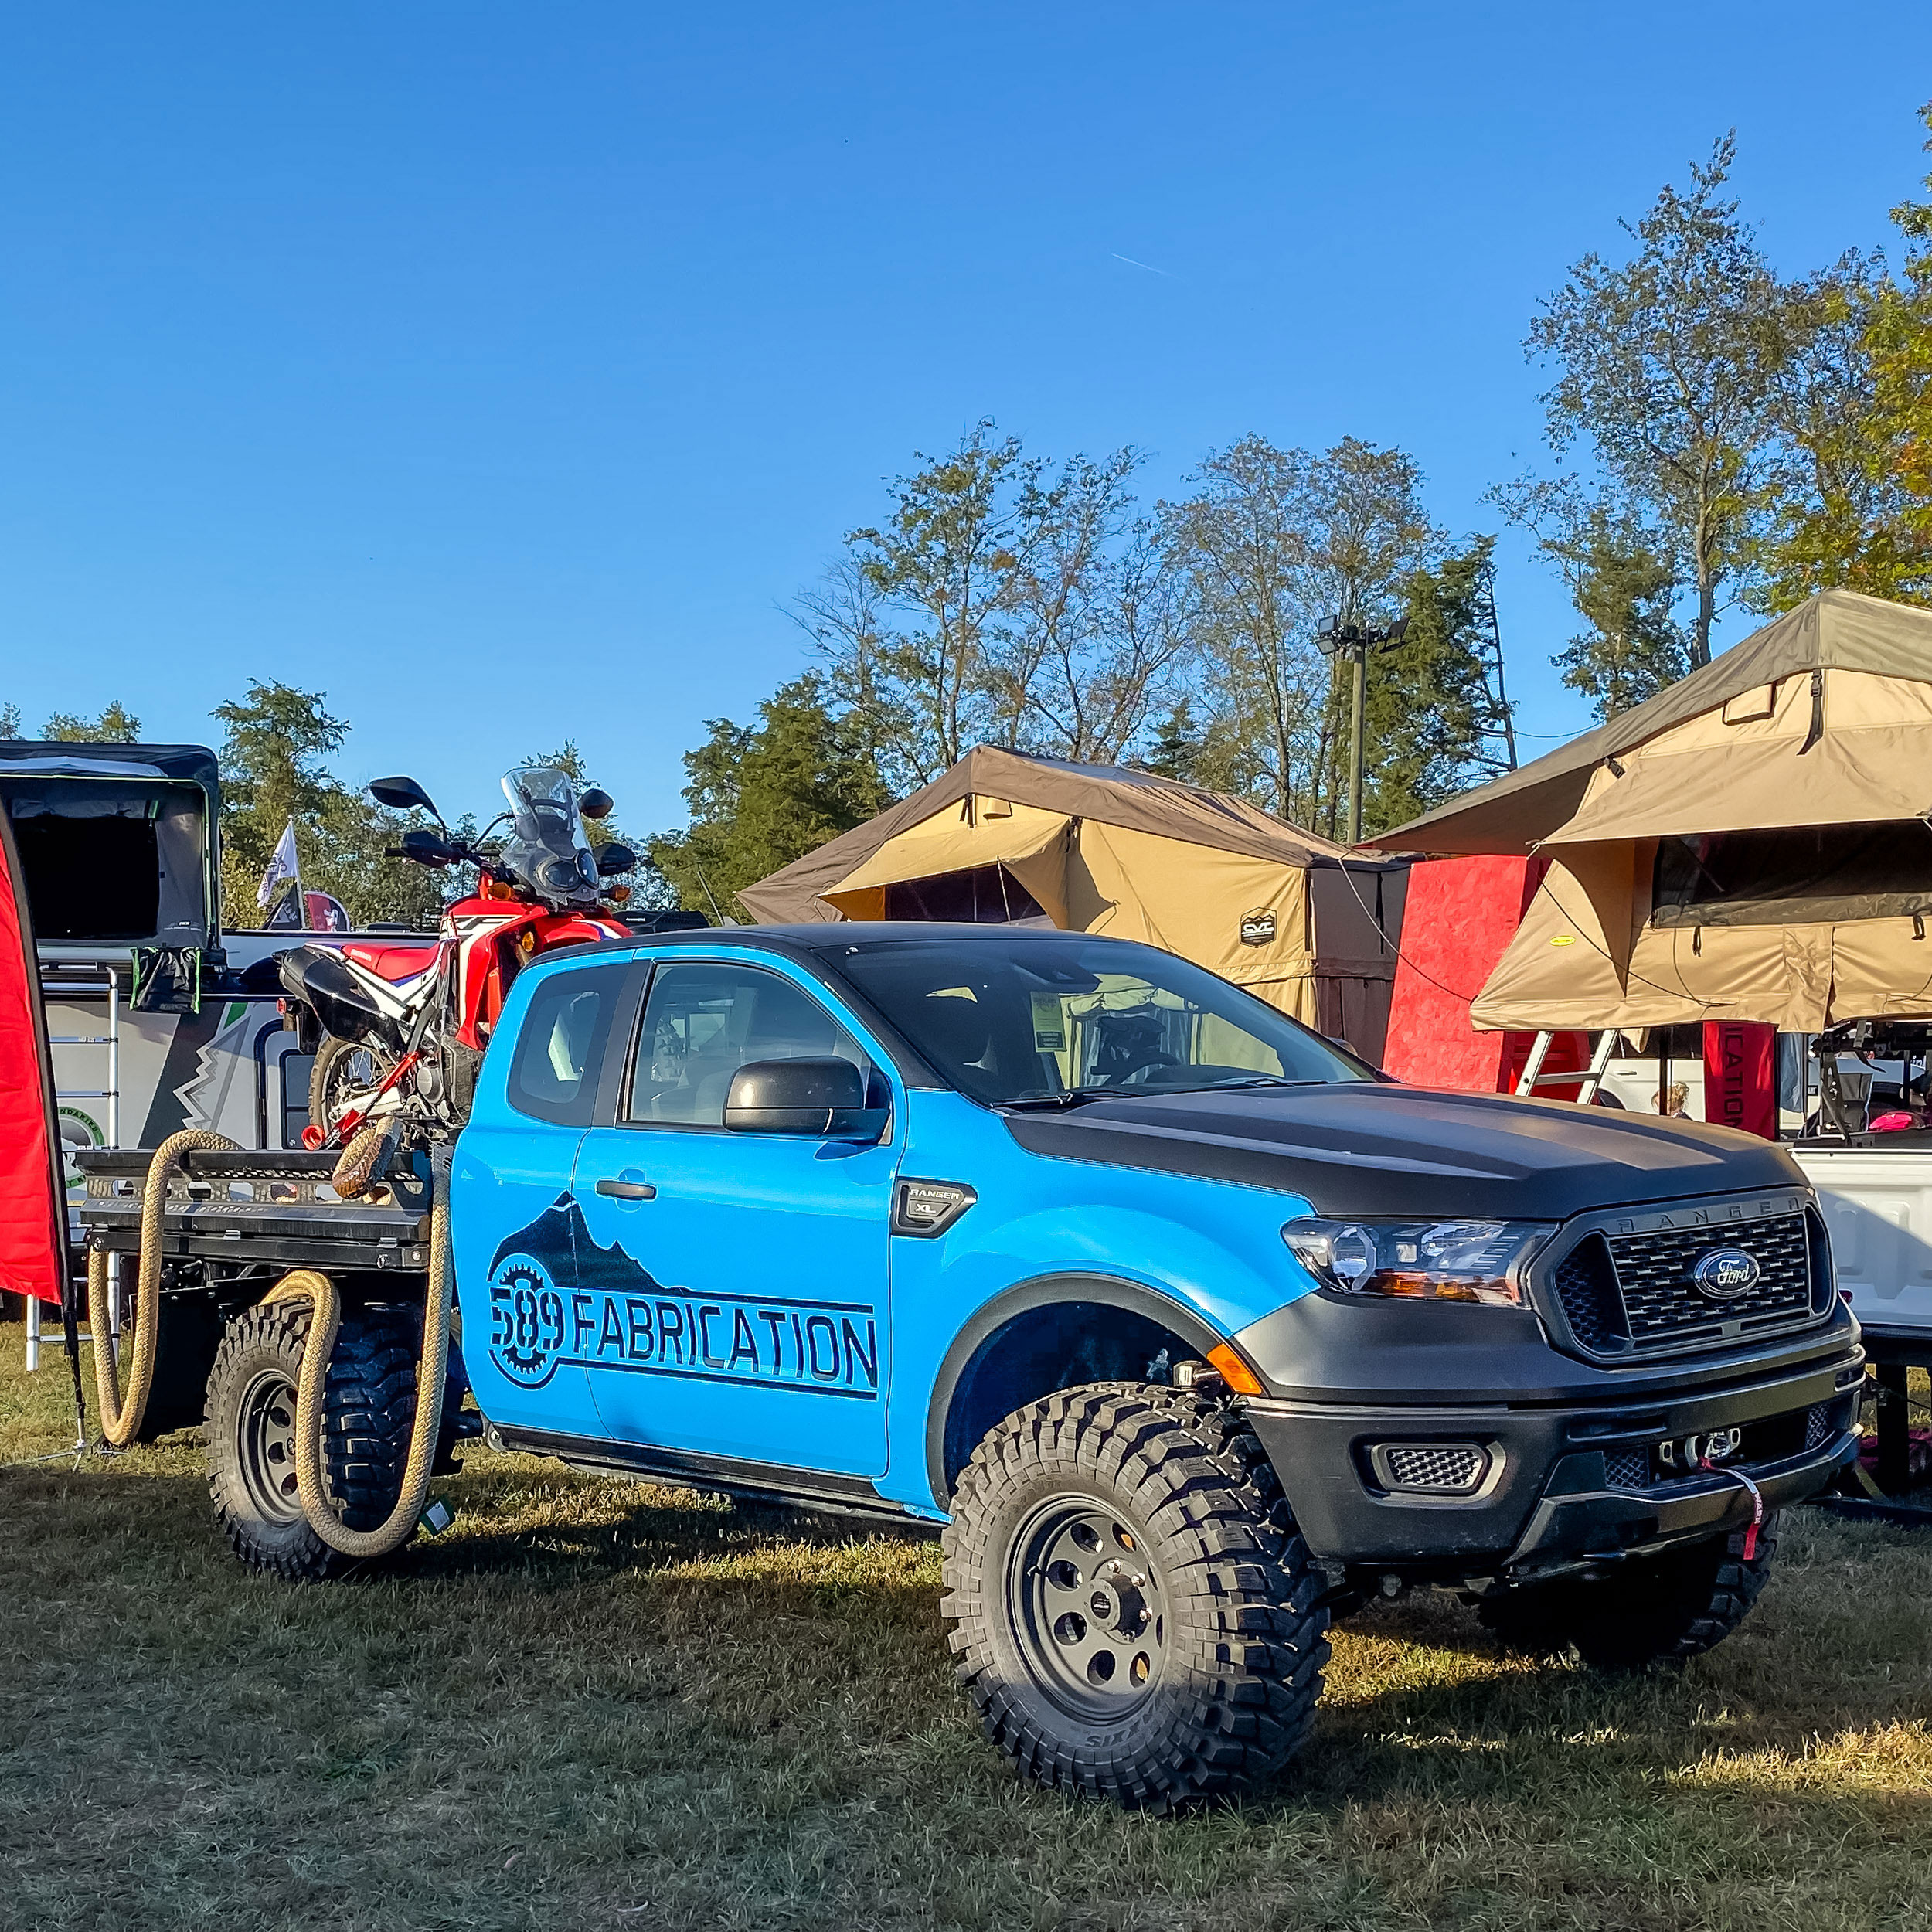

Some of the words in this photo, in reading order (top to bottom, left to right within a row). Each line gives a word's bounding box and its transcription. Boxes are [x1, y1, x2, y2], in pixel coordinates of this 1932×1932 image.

[910, 1188, 960, 1200] RANGER
[915, 1203, 937, 1214] XL
[1616, 1197, 1801, 1233] RANGER
[1716, 1259, 1750, 1287] Ford
[489, 1287, 564, 1352] 589
[572, 1294, 879, 1389] FABRICATION
